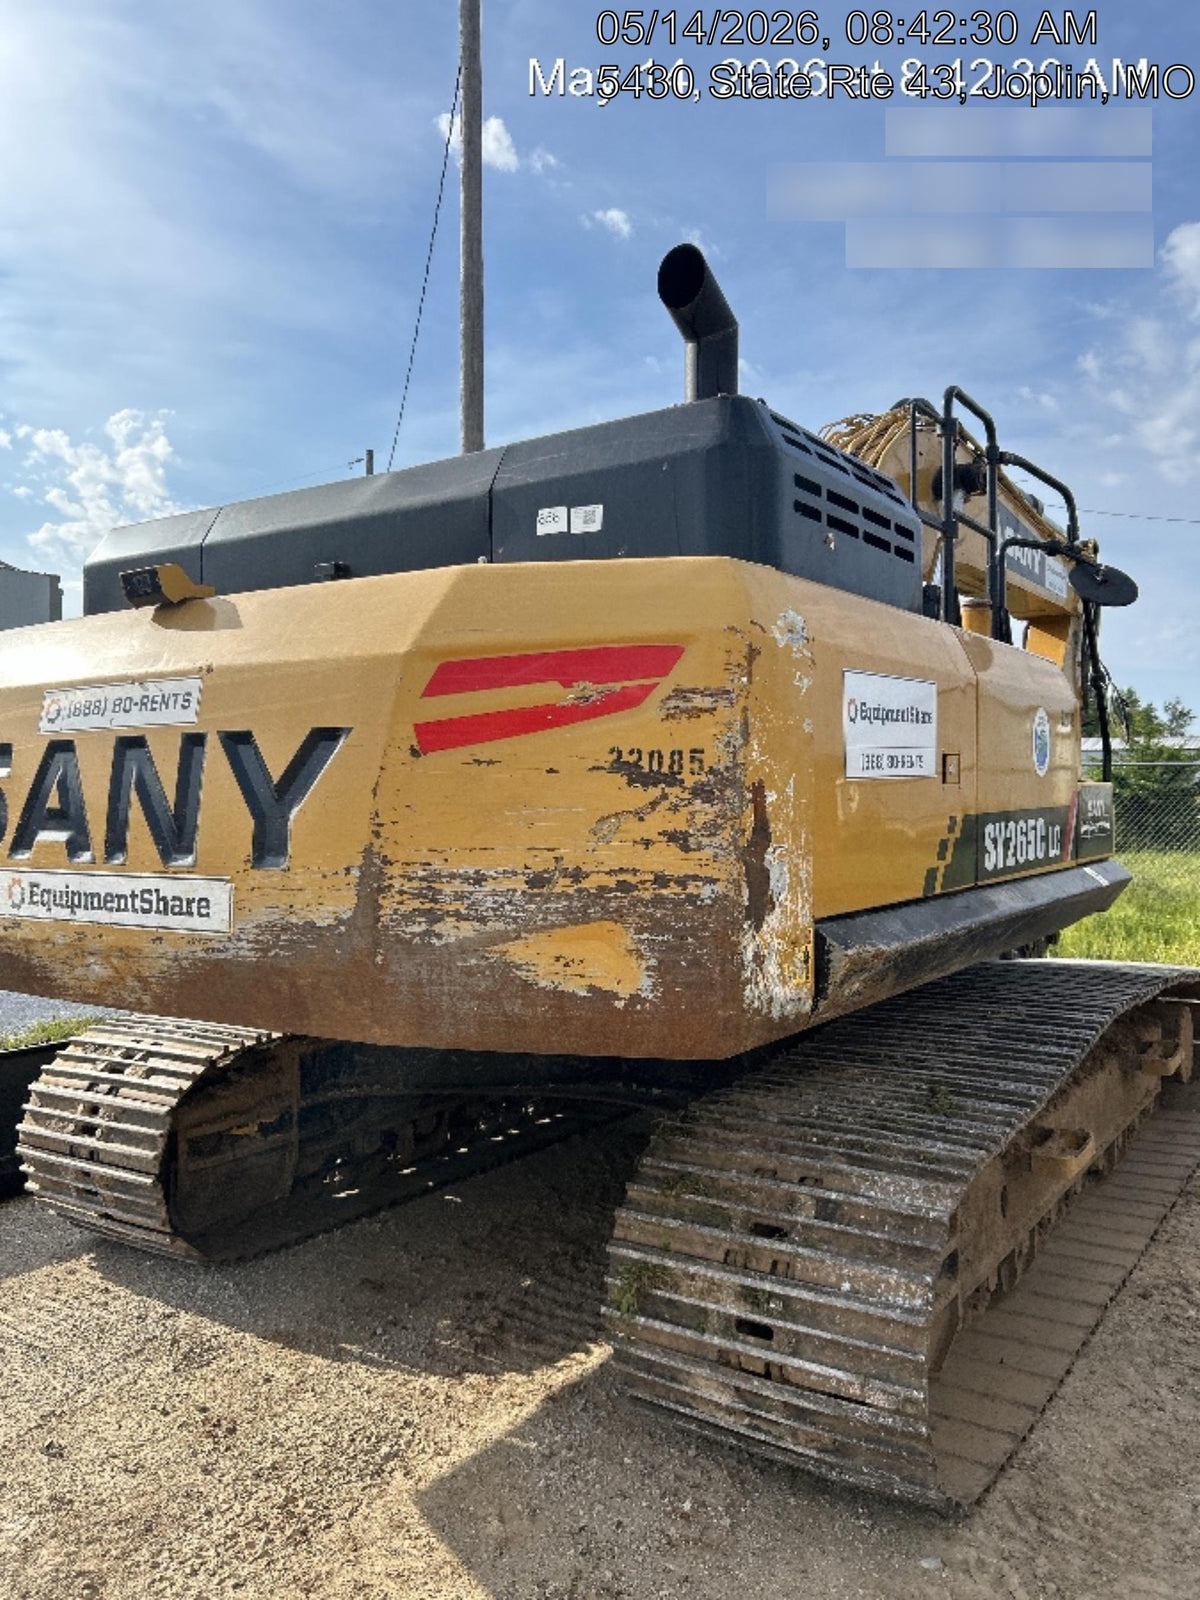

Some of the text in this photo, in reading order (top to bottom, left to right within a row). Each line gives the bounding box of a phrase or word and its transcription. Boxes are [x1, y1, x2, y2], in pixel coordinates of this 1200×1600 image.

[0, 727, 354, 870] ANY
[984, 817, 1061, 872] SY265C LC
[28, 881, 211, 919] EquipmentShare
